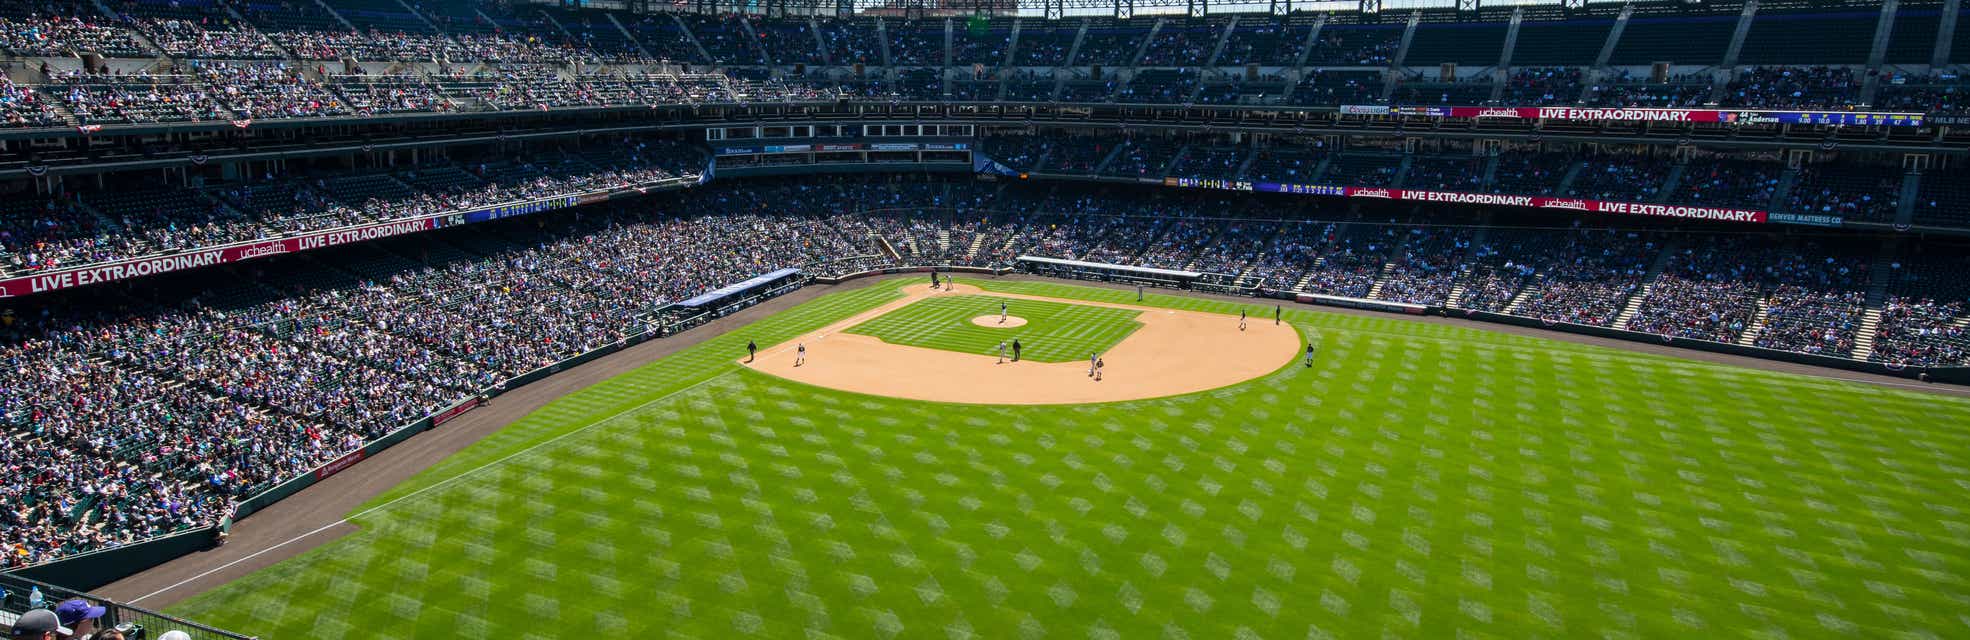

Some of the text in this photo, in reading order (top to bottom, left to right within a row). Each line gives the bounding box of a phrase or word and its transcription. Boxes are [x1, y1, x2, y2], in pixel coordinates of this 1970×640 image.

[1479, 107, 1518, 117] uchealth
[1539, 109, 1692, 121] LIVE EXTRAORDINARY.
[1353, 187, 1389, 198] uchealth
[1401, 190, 1534, 207] LIVE EXTRAORDINARY.
[1545, 198, 1586, 209] uchealth
[1599, 201, 1757, 222] LIVE EXTRAORDINARY.
[1797, 214, 1830, 223] MATTRESS
[298, 219, 428, 250] LIVE EXTRAORDINARY.
[240, 240, 286, 259] uchealth
[31, 272, 73, 293] LIVE
[77, 250, 228, 286] EXTRAORDINARY.
